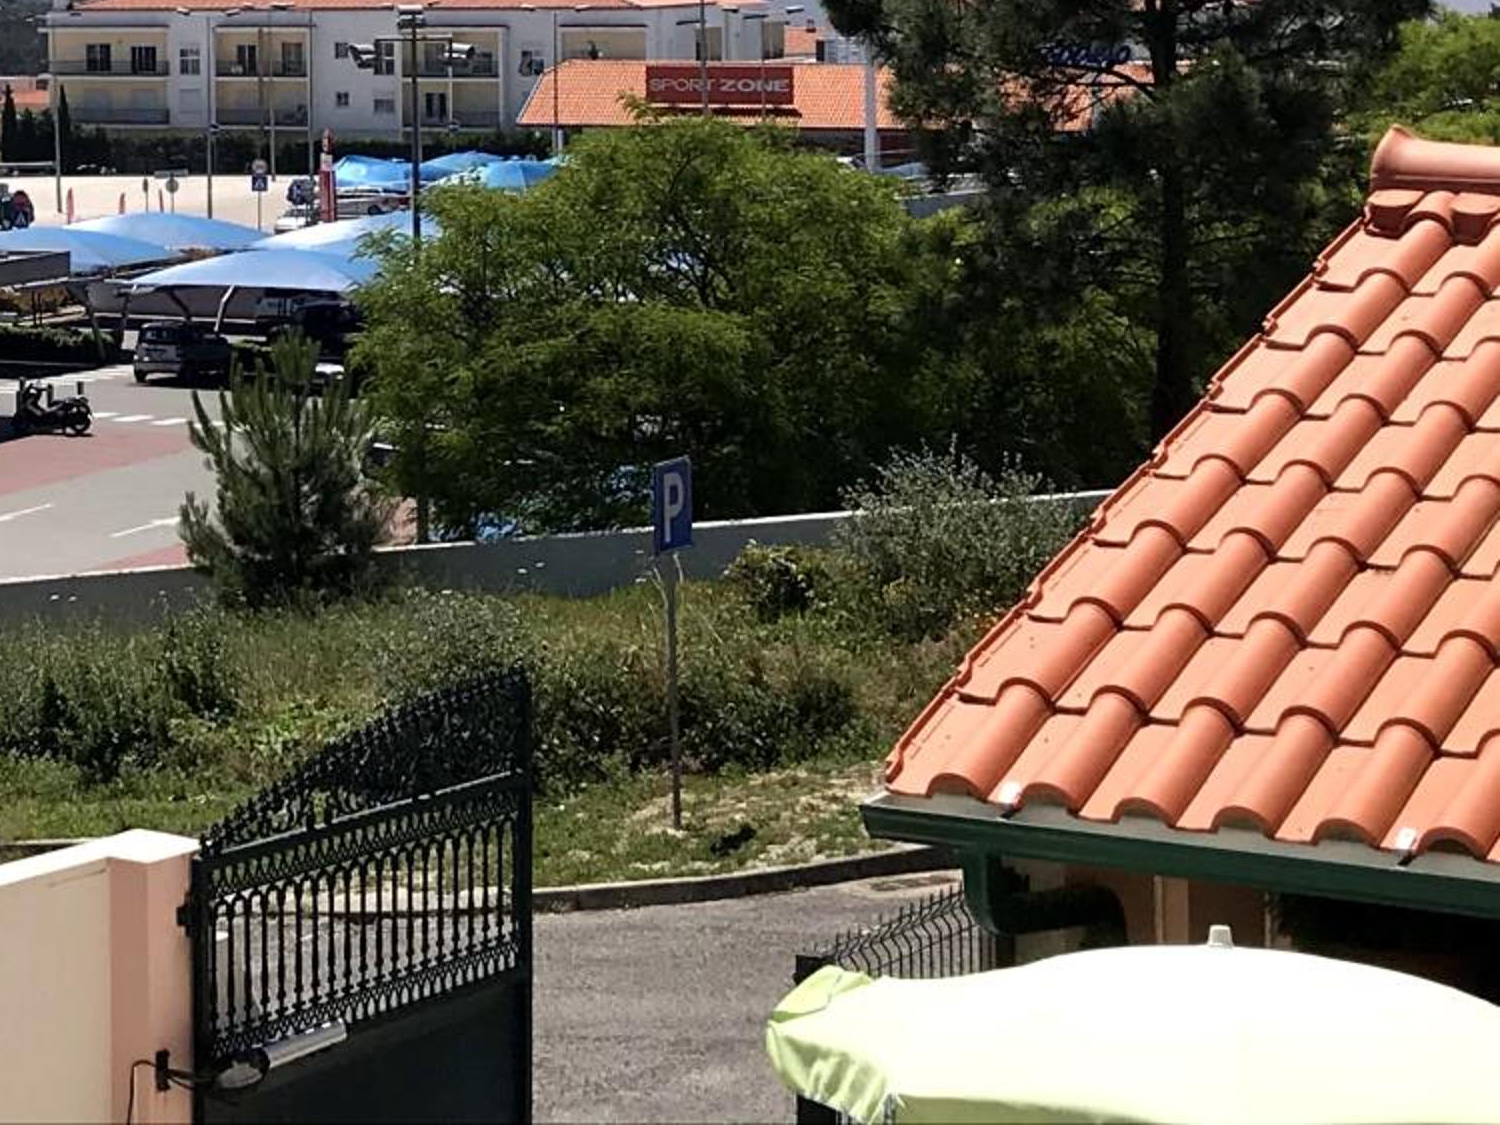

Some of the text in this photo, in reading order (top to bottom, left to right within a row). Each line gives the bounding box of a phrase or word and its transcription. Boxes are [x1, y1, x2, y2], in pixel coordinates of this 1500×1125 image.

[649, 78, 790, 92] SPORT ZONE
[663, 473, 684, 542] P
